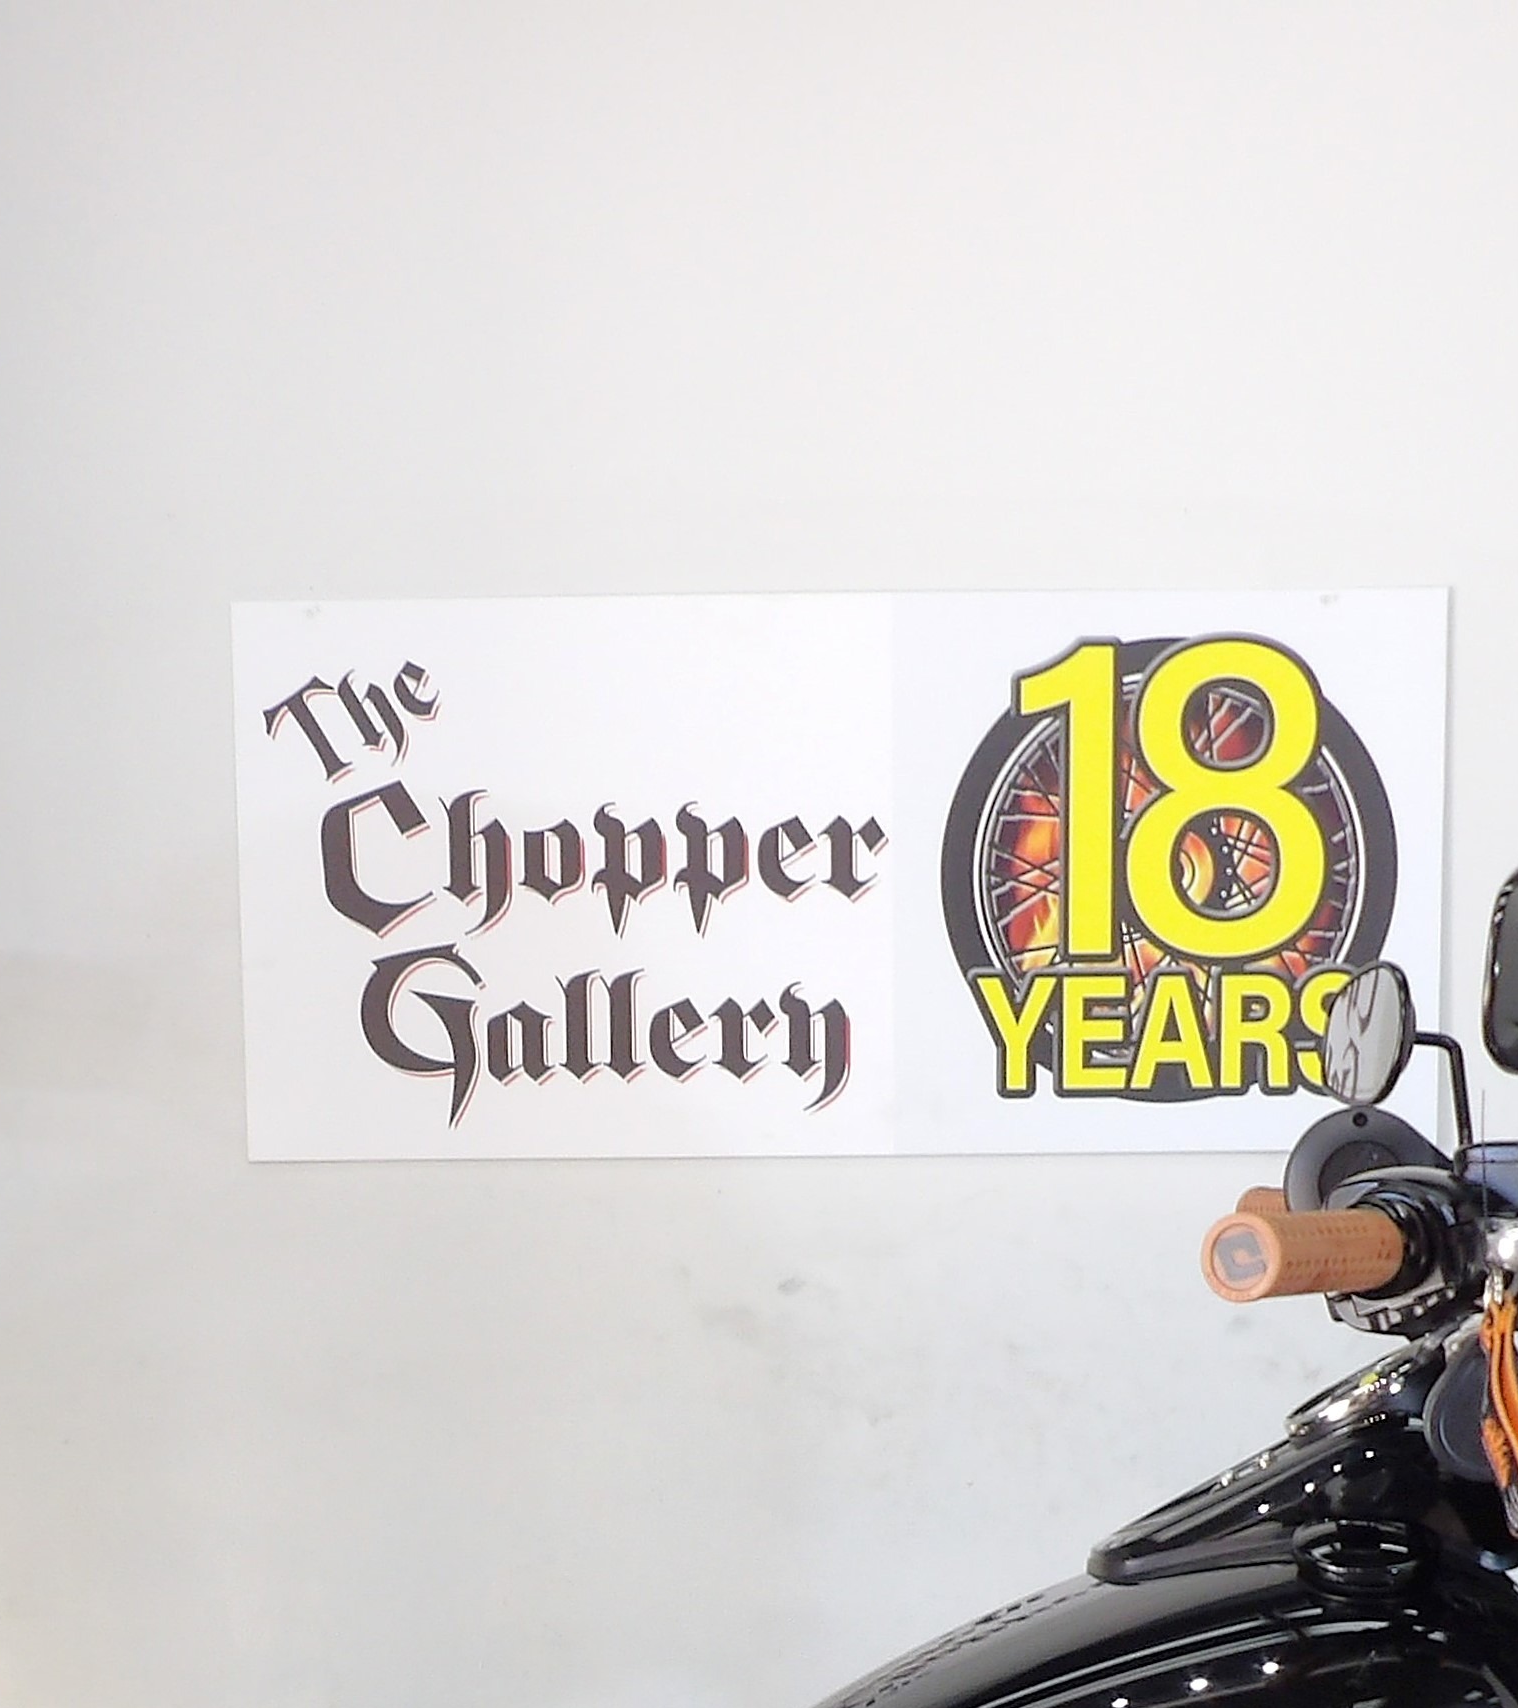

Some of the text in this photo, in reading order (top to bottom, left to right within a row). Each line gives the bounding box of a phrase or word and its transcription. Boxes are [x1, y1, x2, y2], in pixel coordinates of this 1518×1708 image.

[263, 661, 439, 784] The
[1011, 631, 1328, 962] 18
[319, 781, 888, 939] Chopper
[360, 943, 851, 1129] Gallery
